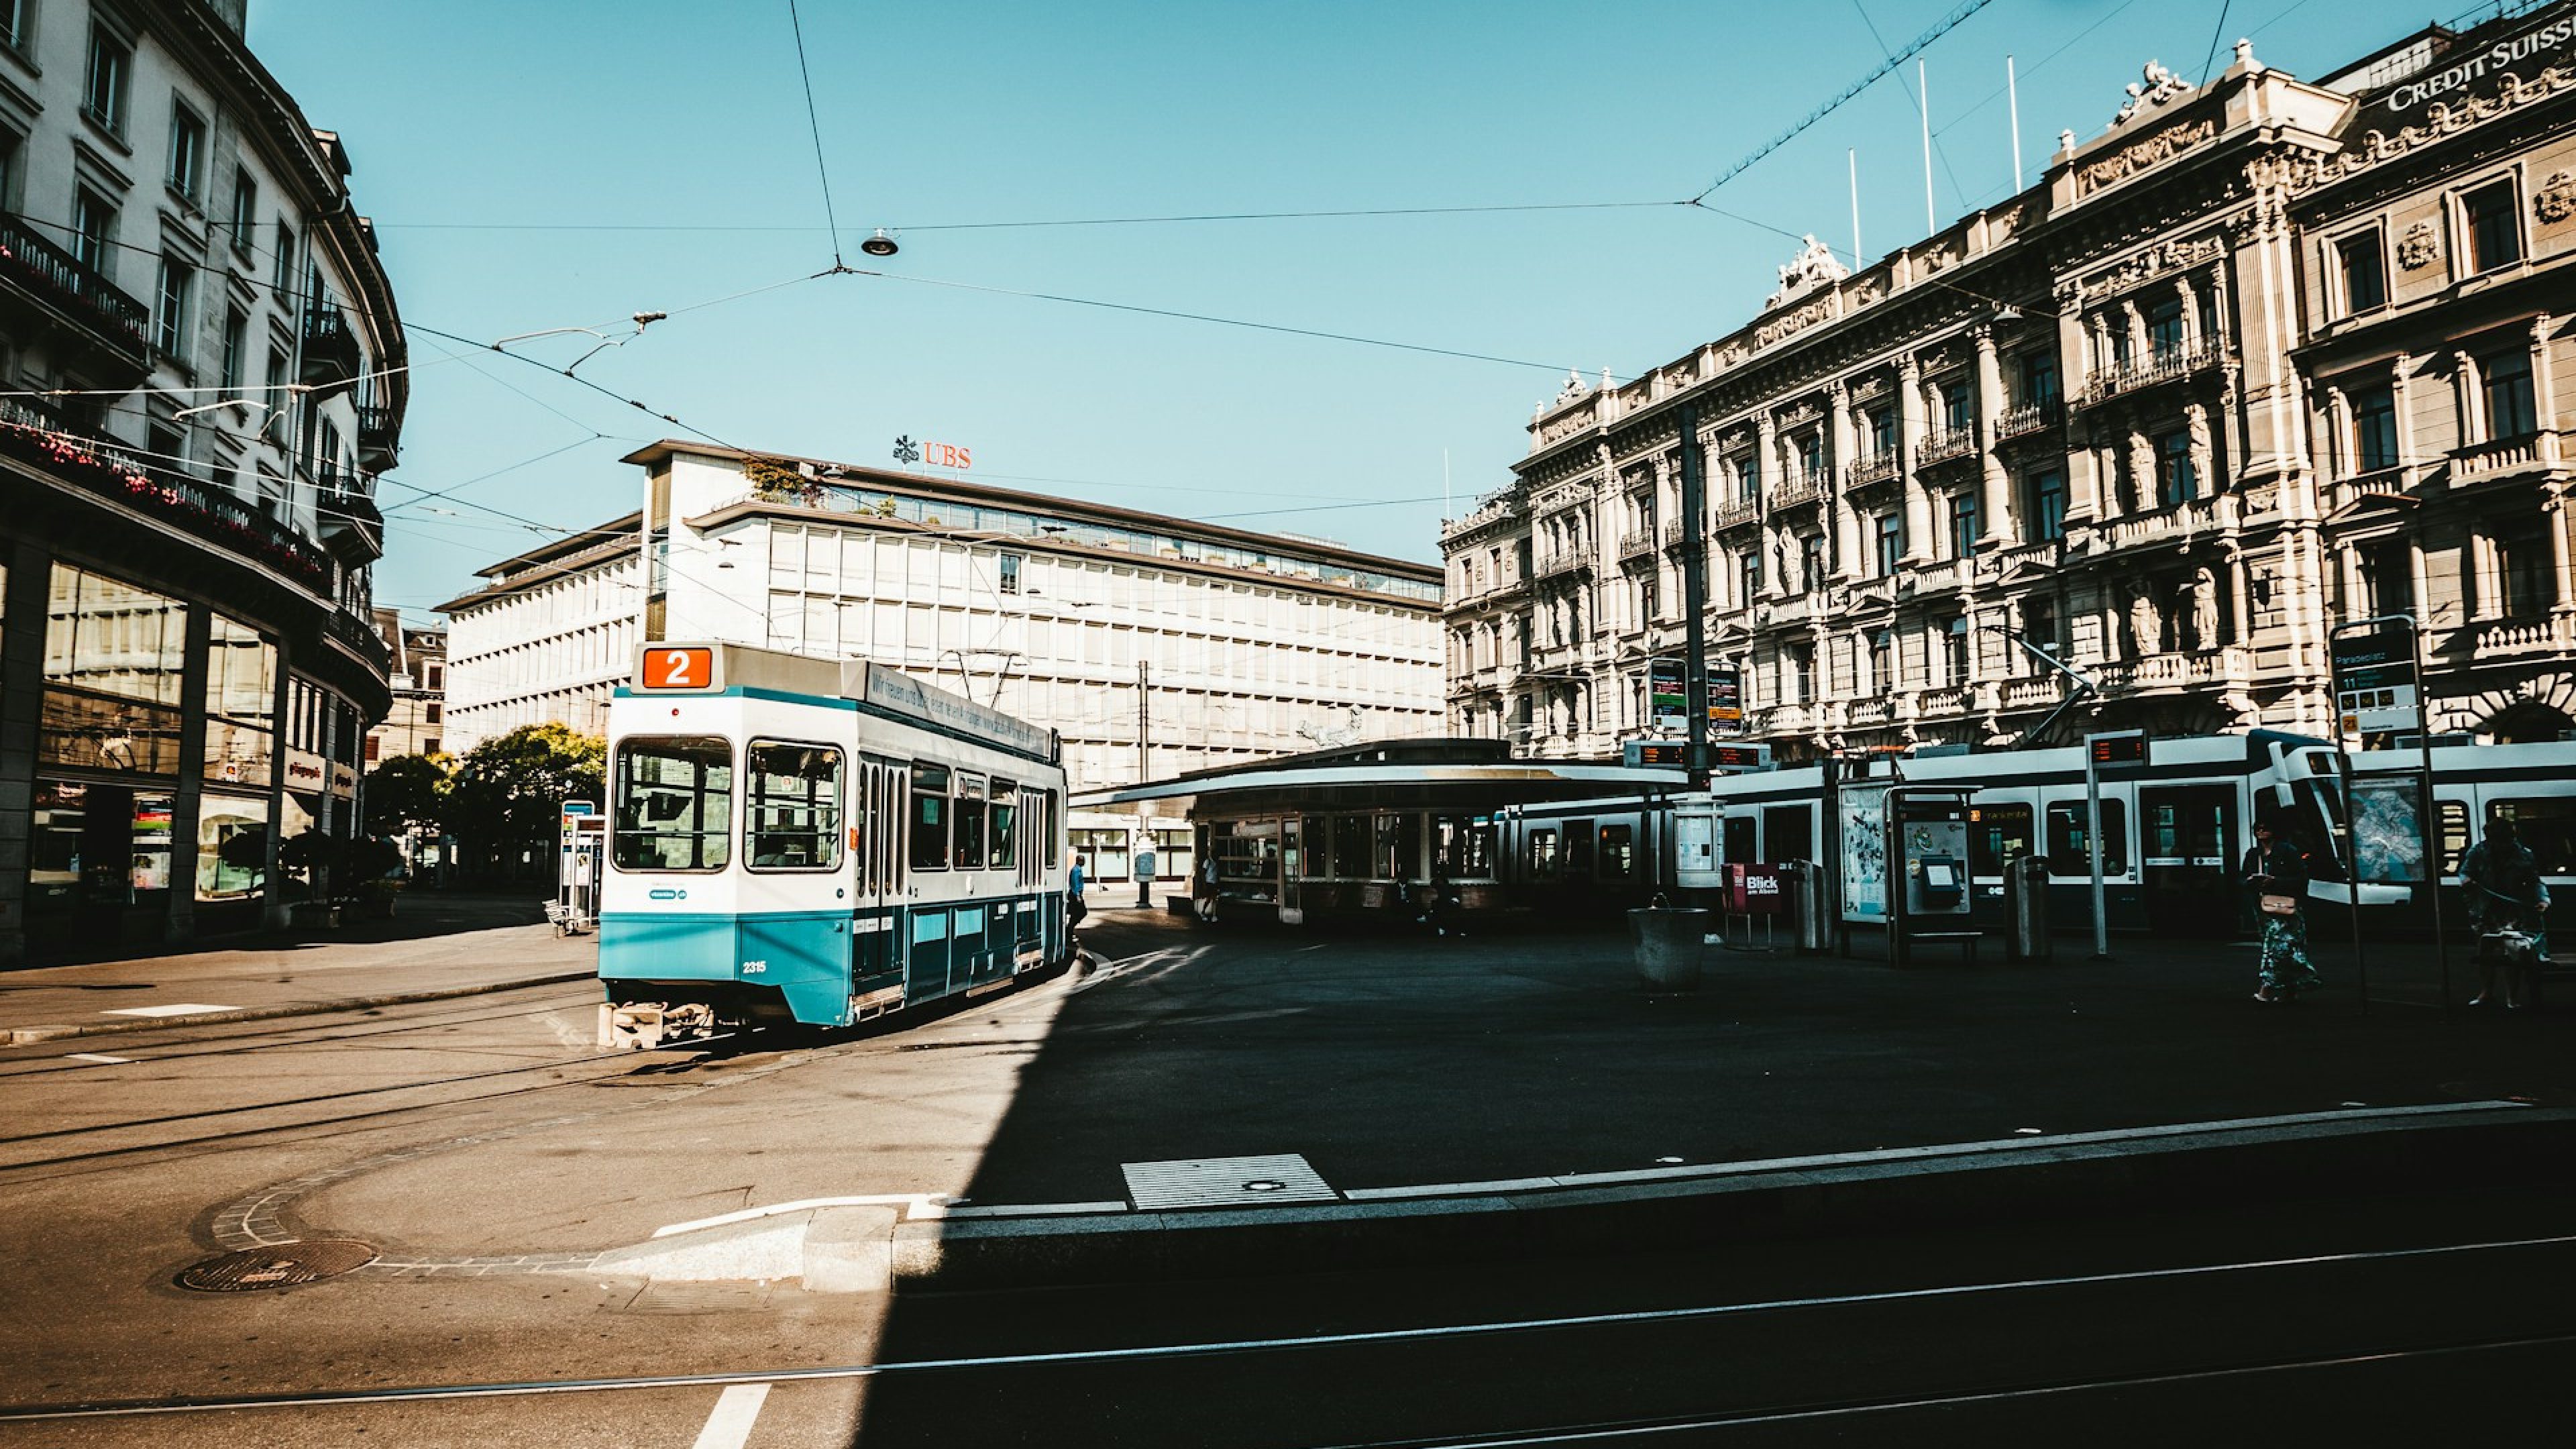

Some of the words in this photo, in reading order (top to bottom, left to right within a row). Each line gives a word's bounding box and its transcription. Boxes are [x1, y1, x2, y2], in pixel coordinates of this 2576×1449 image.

[2387, 54, 2489, 112] CREDIT
[924, 441, 971, 470] UBS
[665, 650, 690, 684] 2
[2344, 678, 2355, 688] 11
[1746, 875, 1778, 889] Blick
[743, 961, 767, 973] 2315
